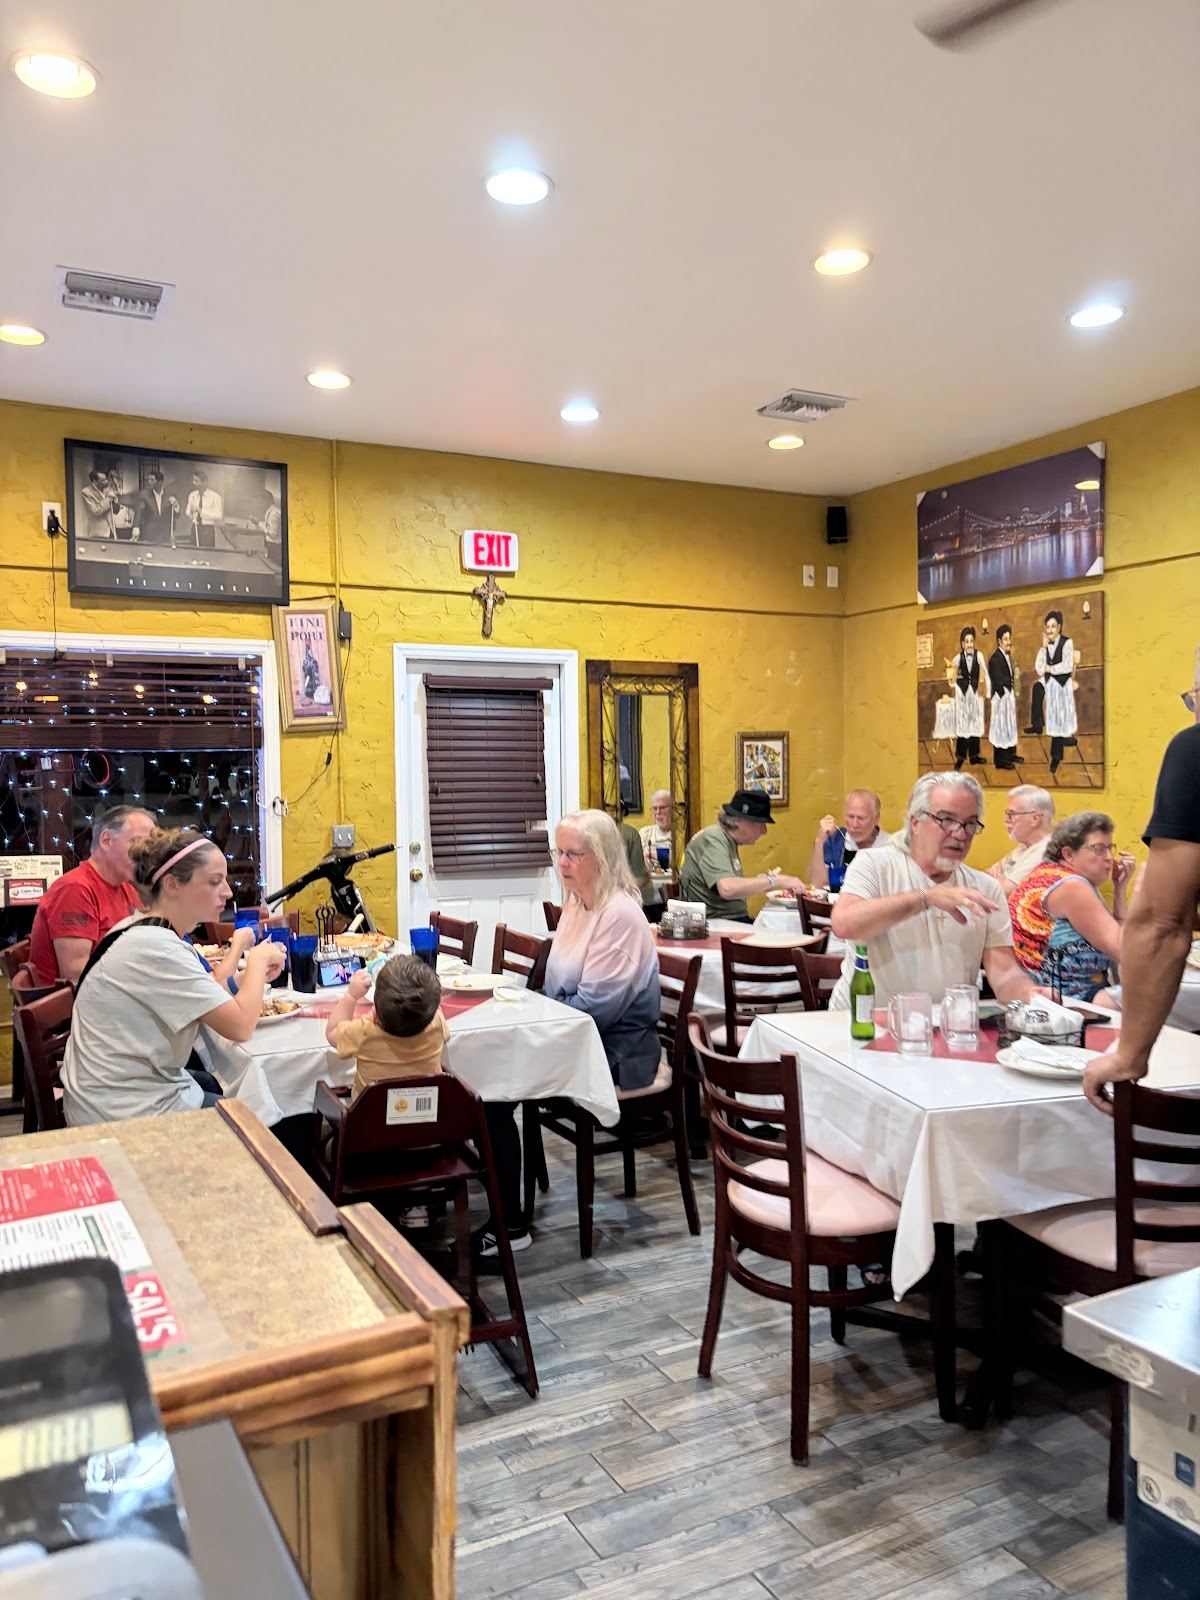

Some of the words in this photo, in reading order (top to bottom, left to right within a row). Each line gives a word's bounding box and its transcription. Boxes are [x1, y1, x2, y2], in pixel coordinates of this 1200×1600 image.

[473, 532, 512, 567] EXIT
[290, 631, 325, 641] PORT
[126, 1280, 178, 1344] SAL'S
